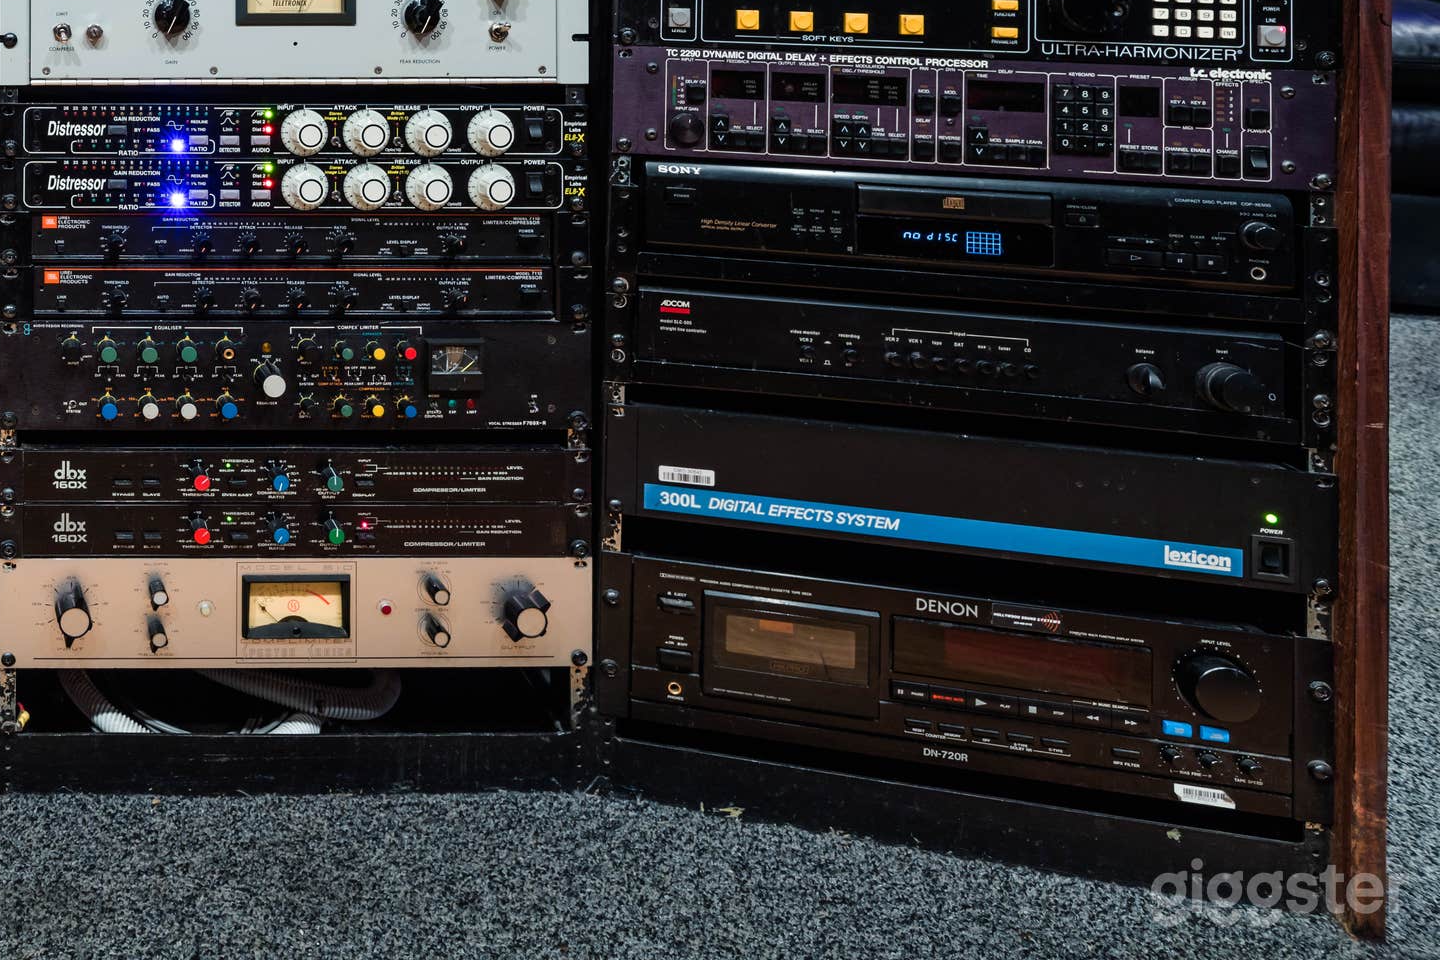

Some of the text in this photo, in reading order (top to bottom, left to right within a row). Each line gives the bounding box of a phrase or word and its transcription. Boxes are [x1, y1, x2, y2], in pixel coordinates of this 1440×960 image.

[680, 49, 701, 57] 2290
[702, 50, 745, 59] DYNAMIC
[747, 51, 783, 60] DIGITAL
[785, 53, 817, 61] DELAY
[829, 54, 874, 64] EFFECTS
[875, 56, 924, 66] CONTROL
[925, 58, 989, 68] PROCESSOR
[1209, 69, 1272, 80] electronic
[47, 121, 106, 137] Distressor
[657, 164, 701, 175] SONY
[47, 175, 106, 191] Distressor
[660, 300, 690, 308] ADCOM
[54, 460, 87, 480] dbx
[52, 481, 87, 490] 160X
[660, 491, 900, 531] 300L DIGITAL EFFECTS SYSTEM
[53, 512, 86, 532] dbx
[51, 534, 87, 543] 160X
[1260, 527, 1283, 535] POWER
[915, 597, 978, 618] DENON
[923, 747, 968, 762] DN-720R
